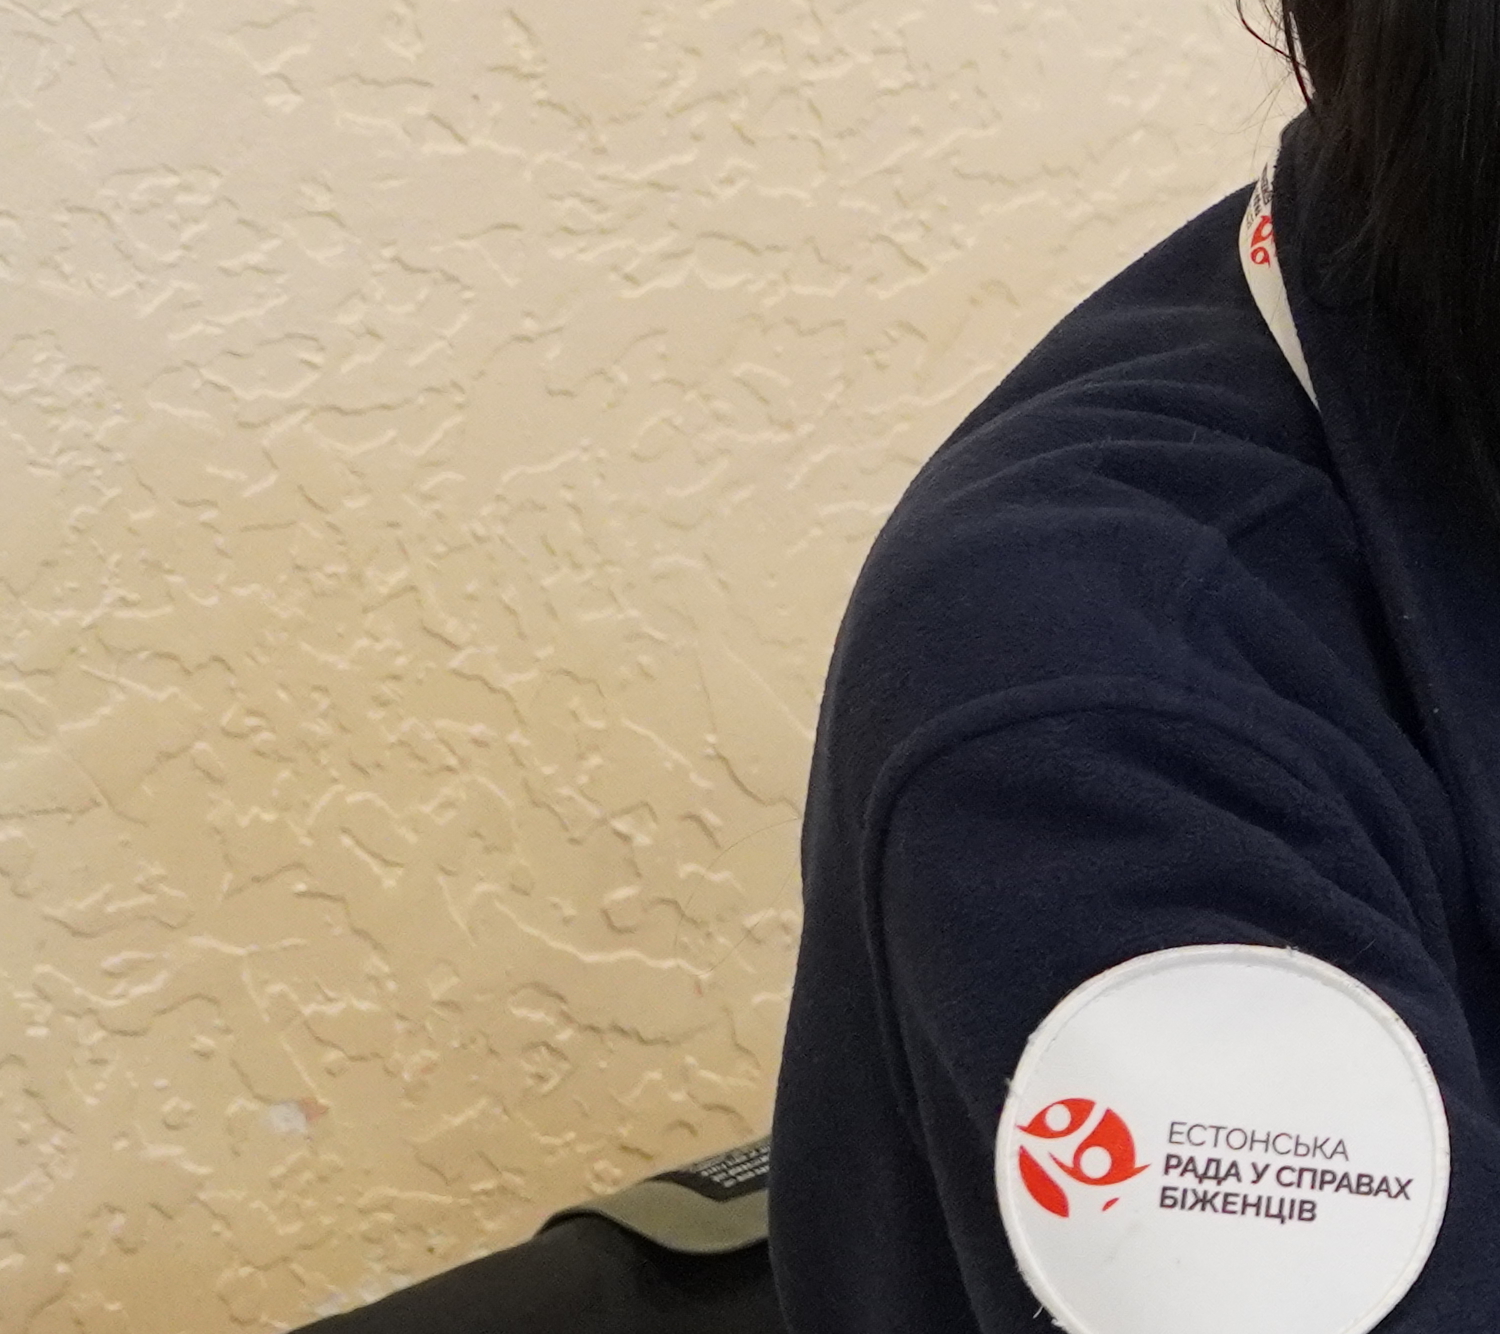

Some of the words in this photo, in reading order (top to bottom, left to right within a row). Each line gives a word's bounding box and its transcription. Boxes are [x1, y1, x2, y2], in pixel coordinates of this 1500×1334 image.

[1168, 1121, 1349, 1161] ЕСТОНСЬКА
[1163, 1153, 1242, 1186] РАДА
[1251, 1161, 1270, 1184] У
[1276, 1165, 1414, 1201] СПРАВАХ
[1159, 1186, 1317, 1224] БІЖЕНЦІВ
